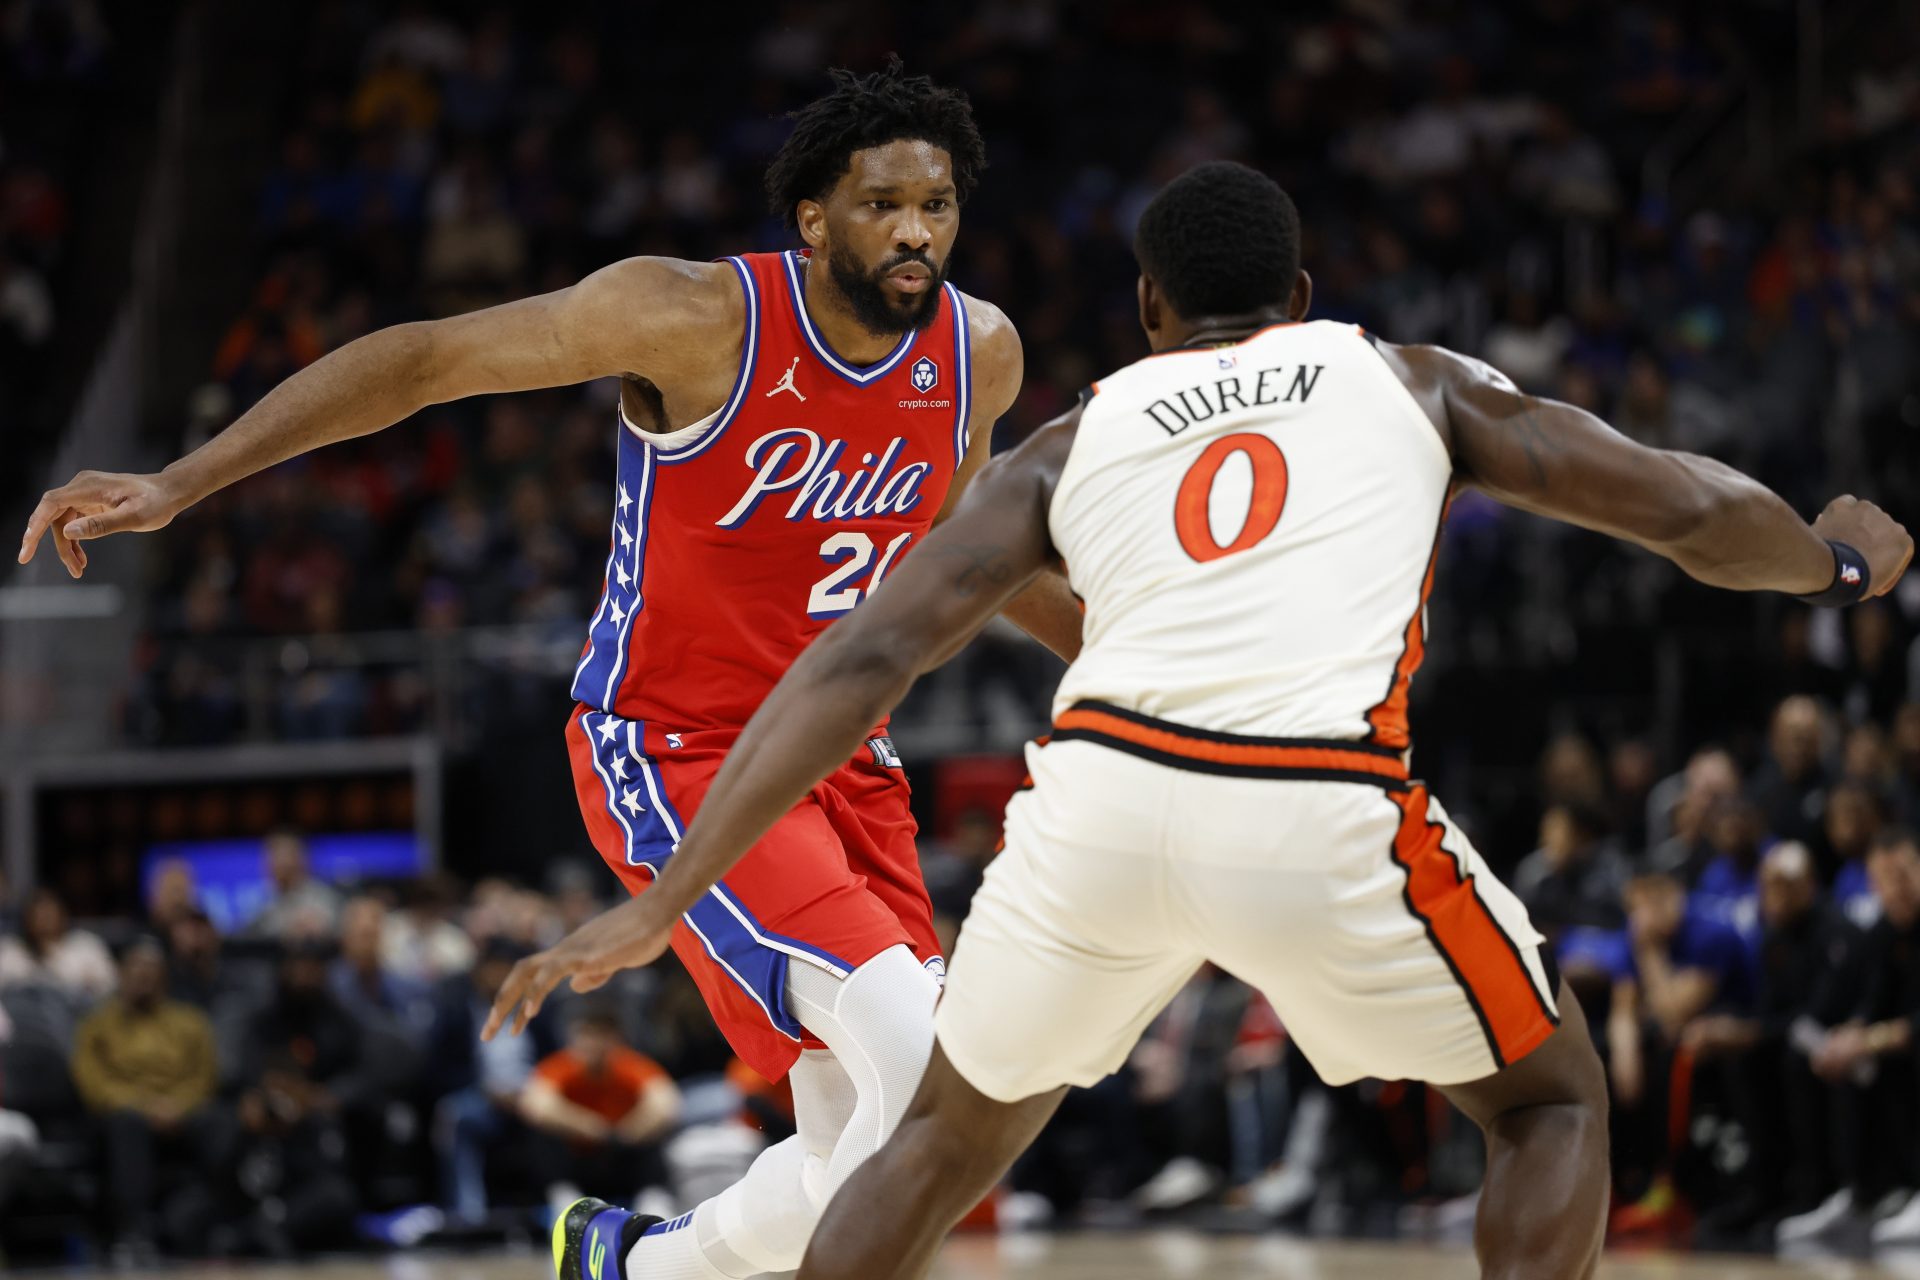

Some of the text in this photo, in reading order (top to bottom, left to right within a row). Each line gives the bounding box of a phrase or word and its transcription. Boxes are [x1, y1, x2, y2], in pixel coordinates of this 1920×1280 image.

[898, 398, 951, 410] crypto.com
[1142, 364, 1326, 437] DUREN
[714, 427, 934, 530] Phila
[1174, 432, 1289, 564] 0
